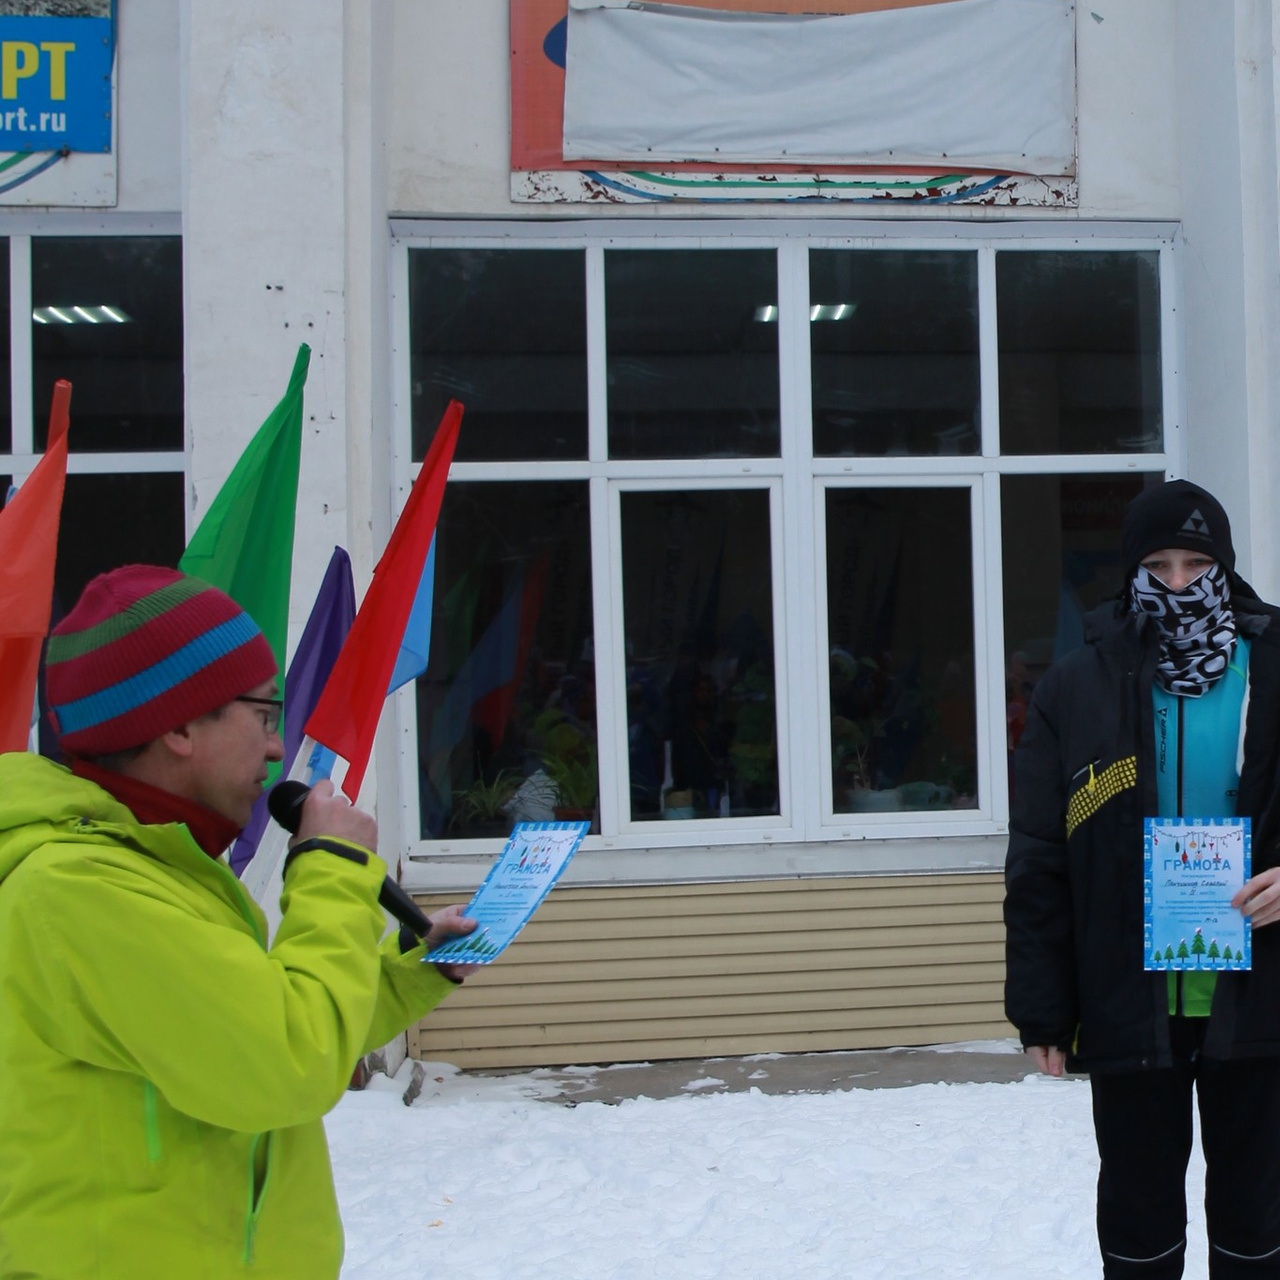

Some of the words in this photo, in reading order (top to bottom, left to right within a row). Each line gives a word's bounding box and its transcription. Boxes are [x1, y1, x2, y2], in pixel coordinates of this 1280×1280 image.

[0, 106, 67, 132] rt.ru
[1159, 718, 1168, 774] FISCHER
[1163, 859, 1232, 871] ГРАМОТА
